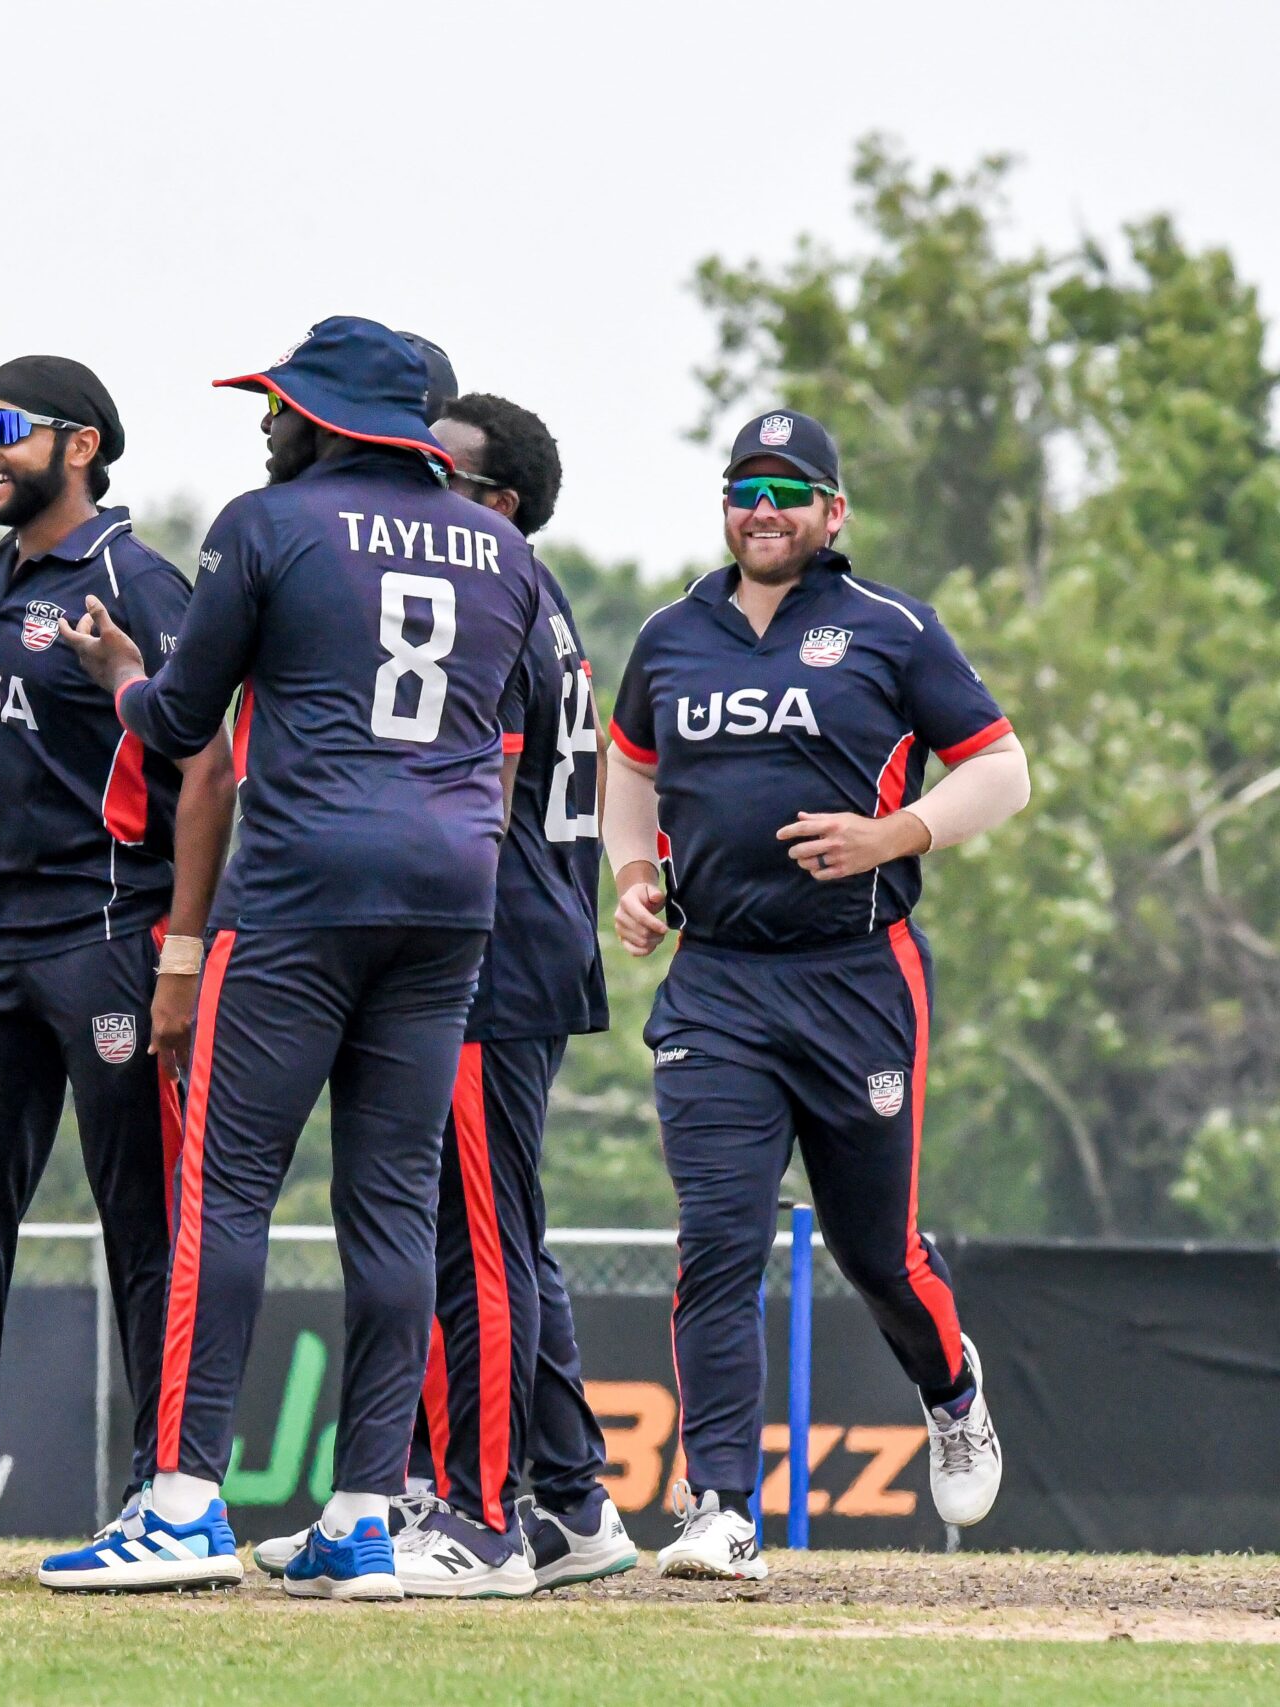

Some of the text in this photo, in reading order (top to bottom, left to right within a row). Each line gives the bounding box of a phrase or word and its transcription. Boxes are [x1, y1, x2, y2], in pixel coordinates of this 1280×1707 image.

[765, 417, 790, 427] USA
[339, 511, 500, 575] TAYLOR
[30, 601, 59, 618] USA
[28, 615, 58, 629] CRICKET
[808, 629, 846, 641] USA
[371, 572, 456, 743] 8
[677, 687, 821, 741] USA
[95, 1017, 133, 1031] USA
[96, 1031, 133, 1040] CRICKET
[871, 1073, 902, 1089] USA
[872, 1086, 902, 1096] CRICKE
